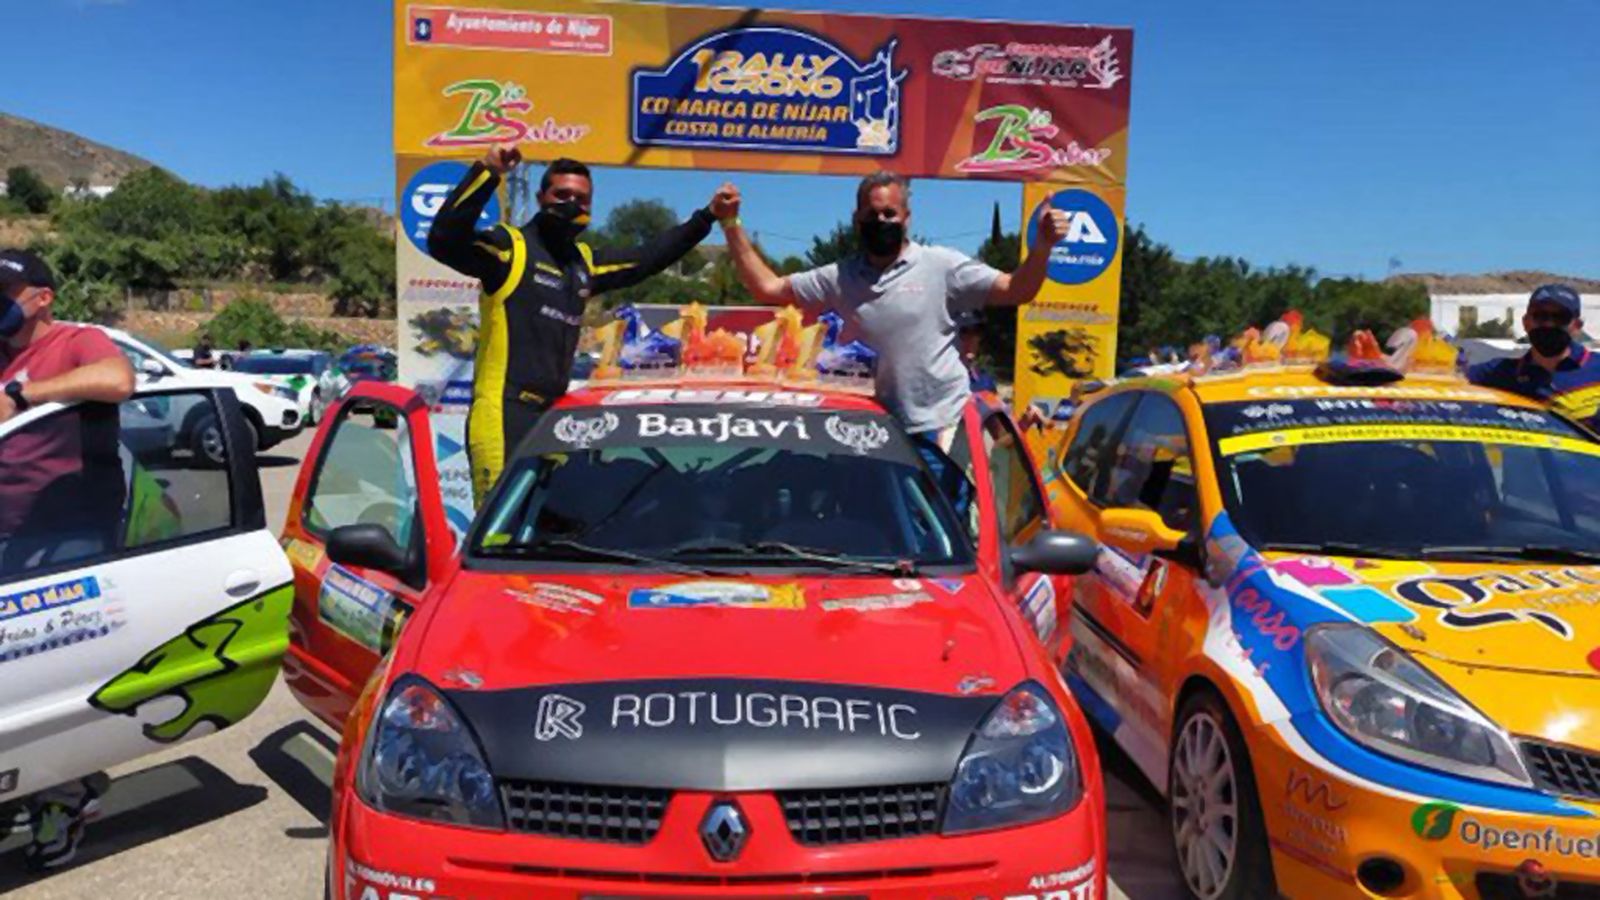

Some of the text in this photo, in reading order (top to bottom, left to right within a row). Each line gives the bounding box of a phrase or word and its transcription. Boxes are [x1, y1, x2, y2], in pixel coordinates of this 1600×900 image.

[546, 18, 563, 34] de
[714, 50, 841, 76] RALLY
[710, 72, 843, 98] CRONO
[641, 96, 747, 119] COMARCA
[751, 100, 778, 120] DE
[665, 119, 718, 138] COSTA
[722, 121, 744, 138] DE
[637, 411, 811, 442] BarJavi
[611, 690, 922, 739] ROTUGRAFIC
